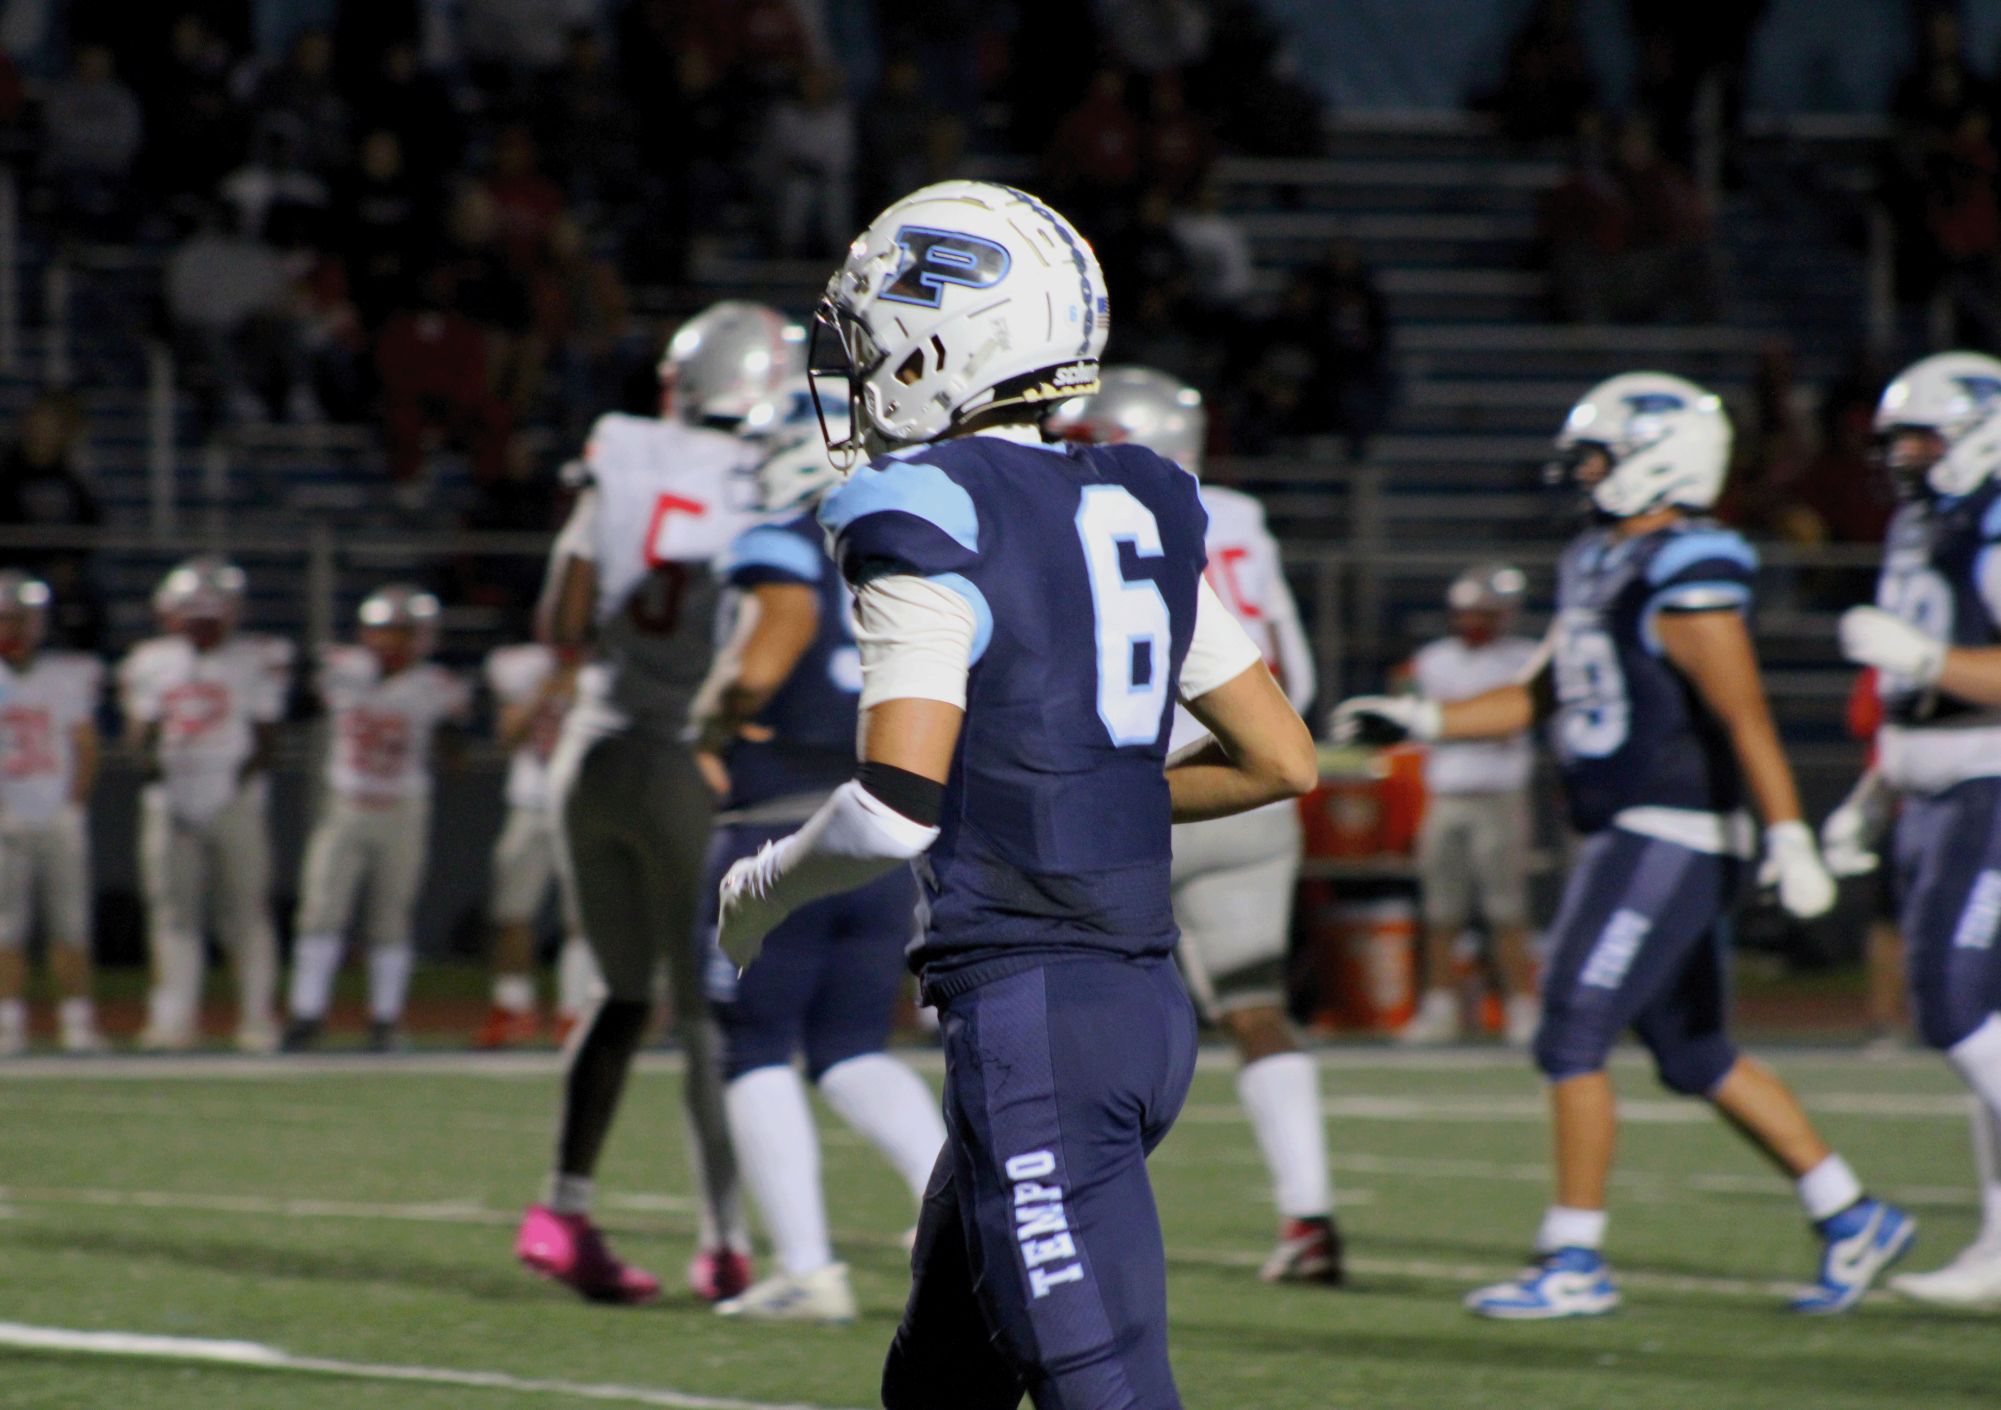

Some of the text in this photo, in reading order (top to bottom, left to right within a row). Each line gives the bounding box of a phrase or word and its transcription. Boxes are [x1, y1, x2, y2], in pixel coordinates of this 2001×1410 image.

[878, 225, 1012, 310] P
[631, 493, 706, 636] 5
[1074, 483, 1171, 748] 6
[1005, 1150, 1084, 1299] TEMPO
